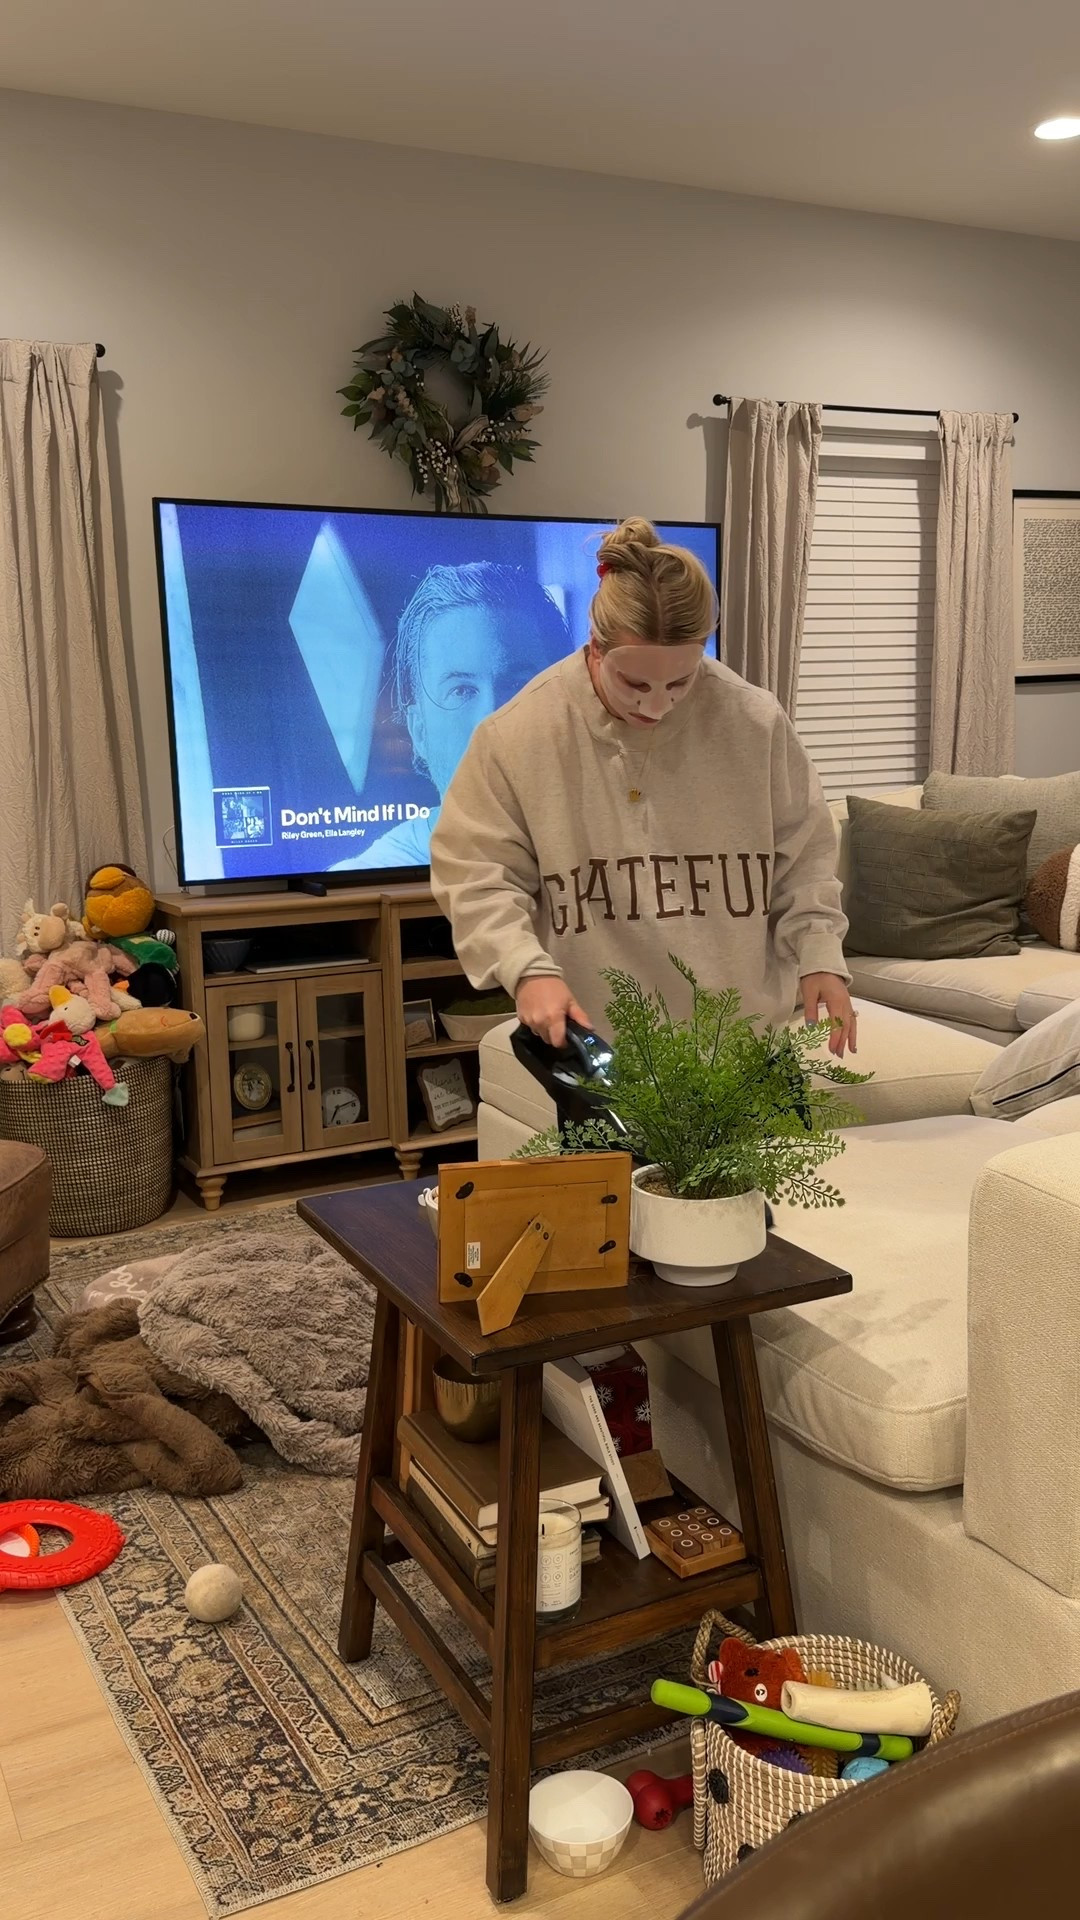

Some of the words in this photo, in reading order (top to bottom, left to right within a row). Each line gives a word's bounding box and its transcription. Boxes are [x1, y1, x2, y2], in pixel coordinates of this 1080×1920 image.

[281, 807, 332, 827] Don't
[334, 805, 380, 824] Mind
[382, 804, 395, 821] If
[397, 803, 403, 820] I
[405, 803, 430, 820] Do
[281, 831, 300, 840] Riley
[300, 830, 325, 839] Green,
[324, 829, 338, 838] Ella
[338, 828, 366, 838] Langley
